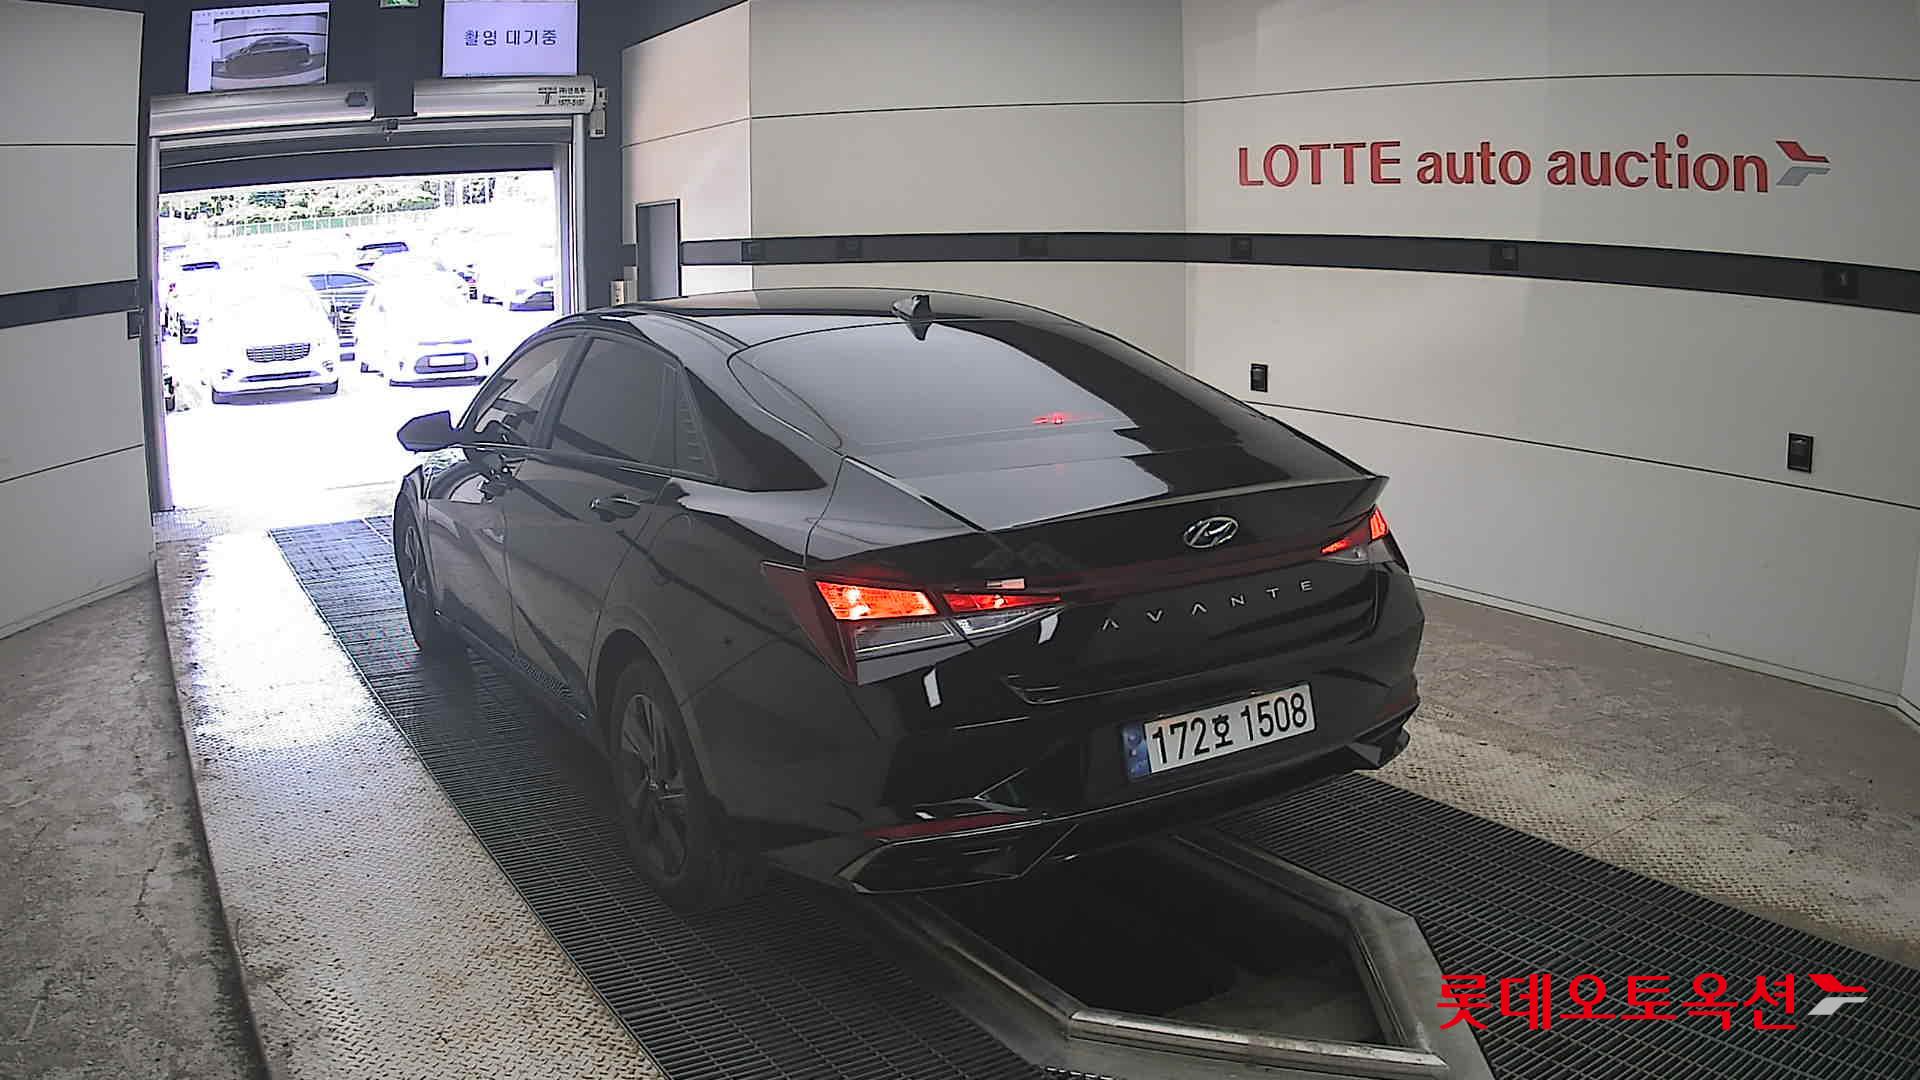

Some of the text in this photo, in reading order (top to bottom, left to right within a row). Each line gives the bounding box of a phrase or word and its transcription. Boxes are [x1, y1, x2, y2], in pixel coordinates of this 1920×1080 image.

[464, 29, 558, 47] 촬영 대기중
[1238, 134, 1769, 193] LOTTE auto auction
[1102, 580, 1313, 630] AVANTE
[1152, 692, 1308, 764] 172호 1508
